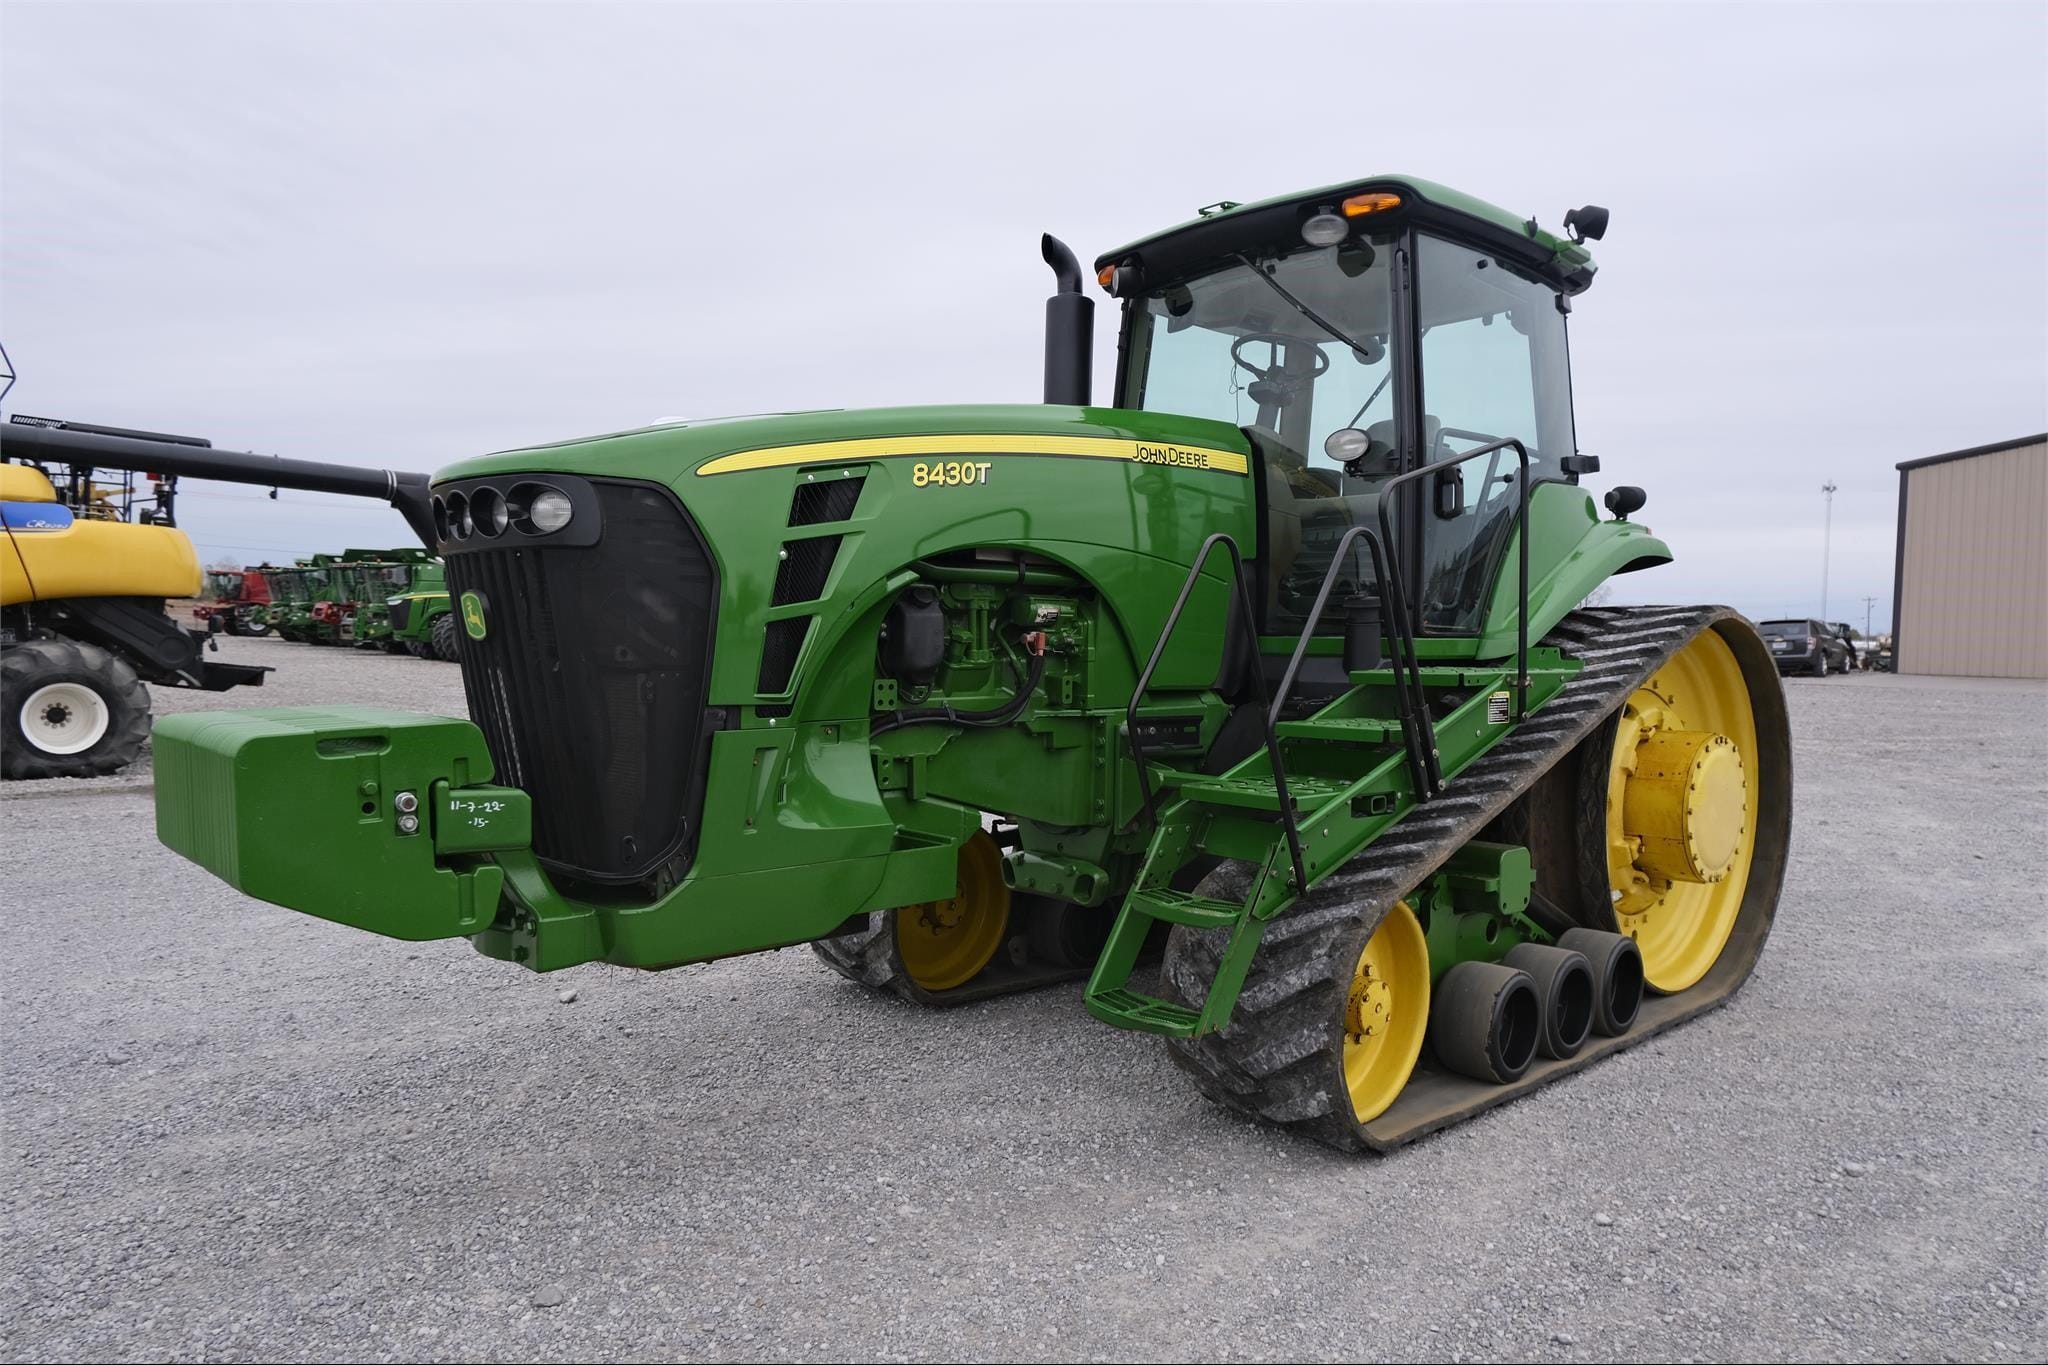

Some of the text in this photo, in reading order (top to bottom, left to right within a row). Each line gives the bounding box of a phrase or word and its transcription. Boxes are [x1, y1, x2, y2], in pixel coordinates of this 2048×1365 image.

[1132, 443, 1209, 468] JOHN DEERE
[912, 461, 992, 487] 8430T
